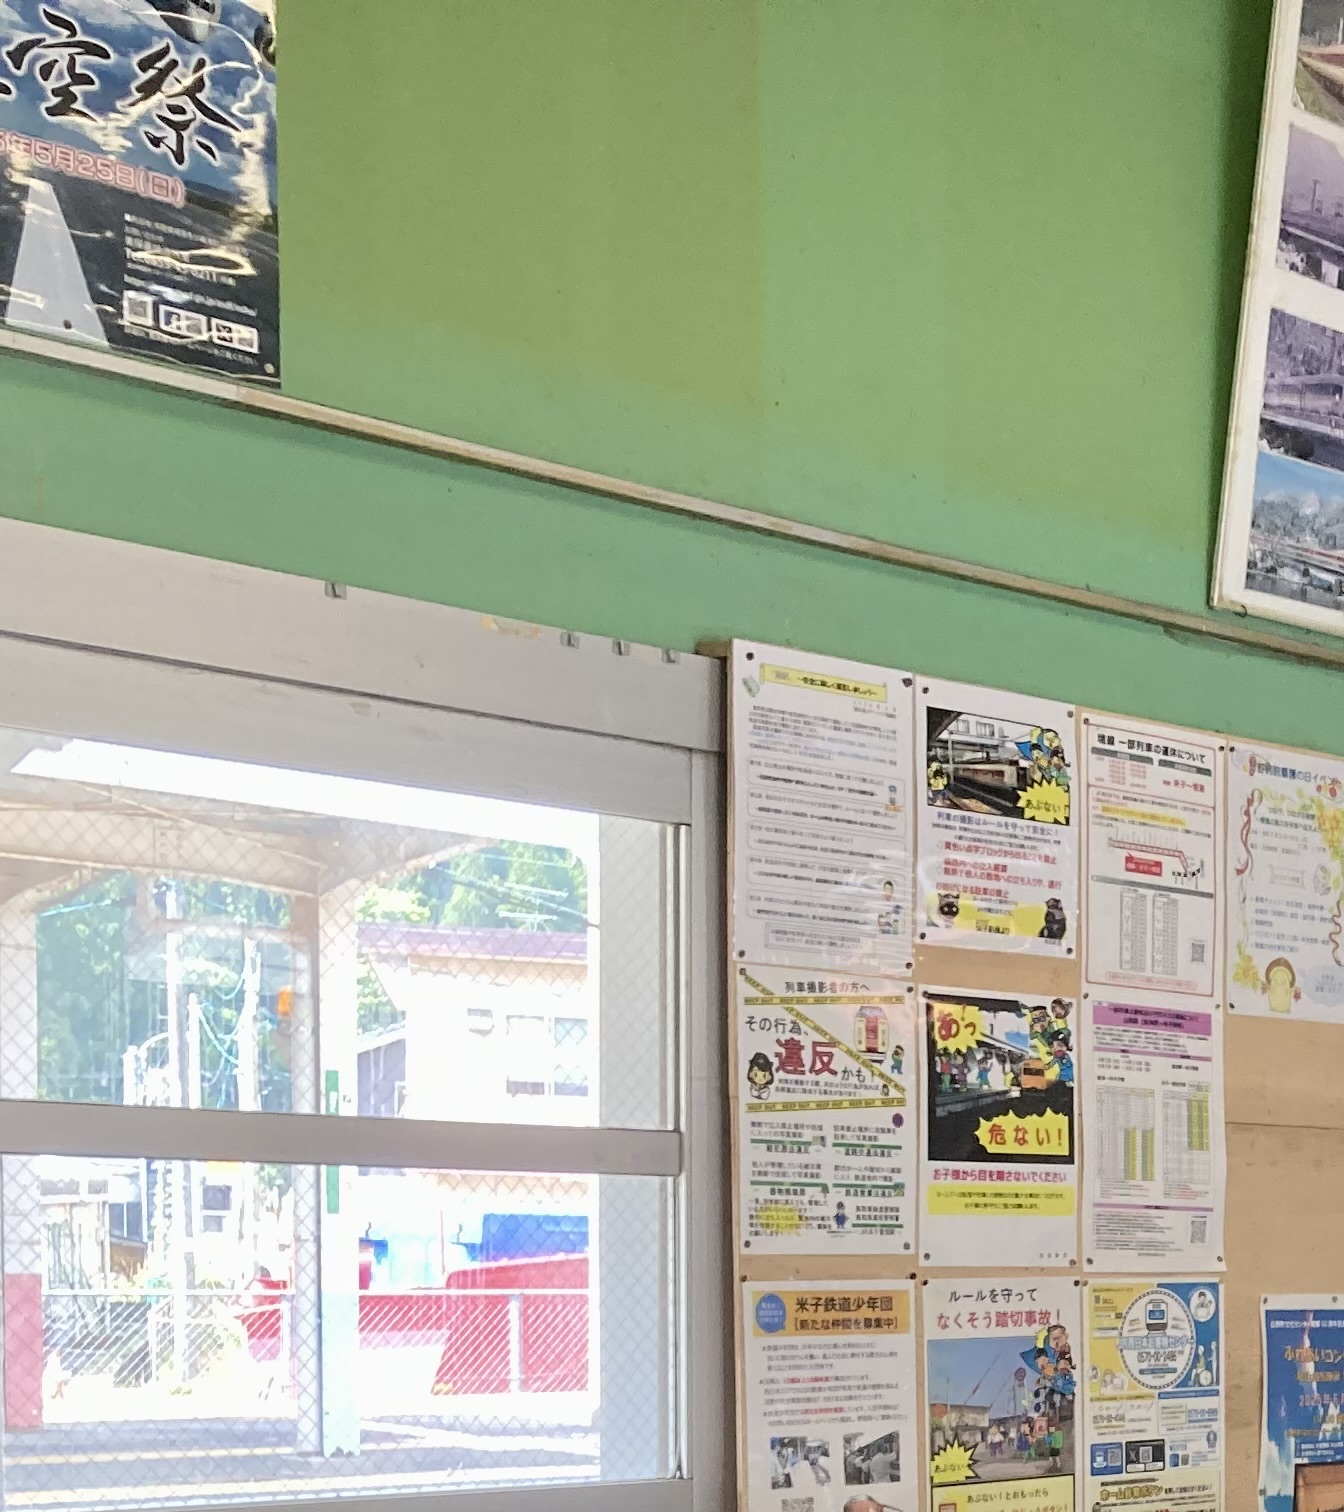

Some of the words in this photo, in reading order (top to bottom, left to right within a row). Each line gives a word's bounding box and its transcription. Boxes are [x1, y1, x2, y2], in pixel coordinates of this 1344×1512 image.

[0, 5, 243, 168] 空祭
[784, 980, 870, 994] 列車撮影者の方へ
[745, 1015, 809, 1036] その行為、
[774, 1037, 838, 1078] 違反
[988, 1124, 1063, 1147] 危ない！
[795, 1296, 893, 1313] 米子鉄道少年団
[948, 1288, 1038, 1304] ルールを守って
[937, 1309, 1060, 1330] なくそう踏切事故！
